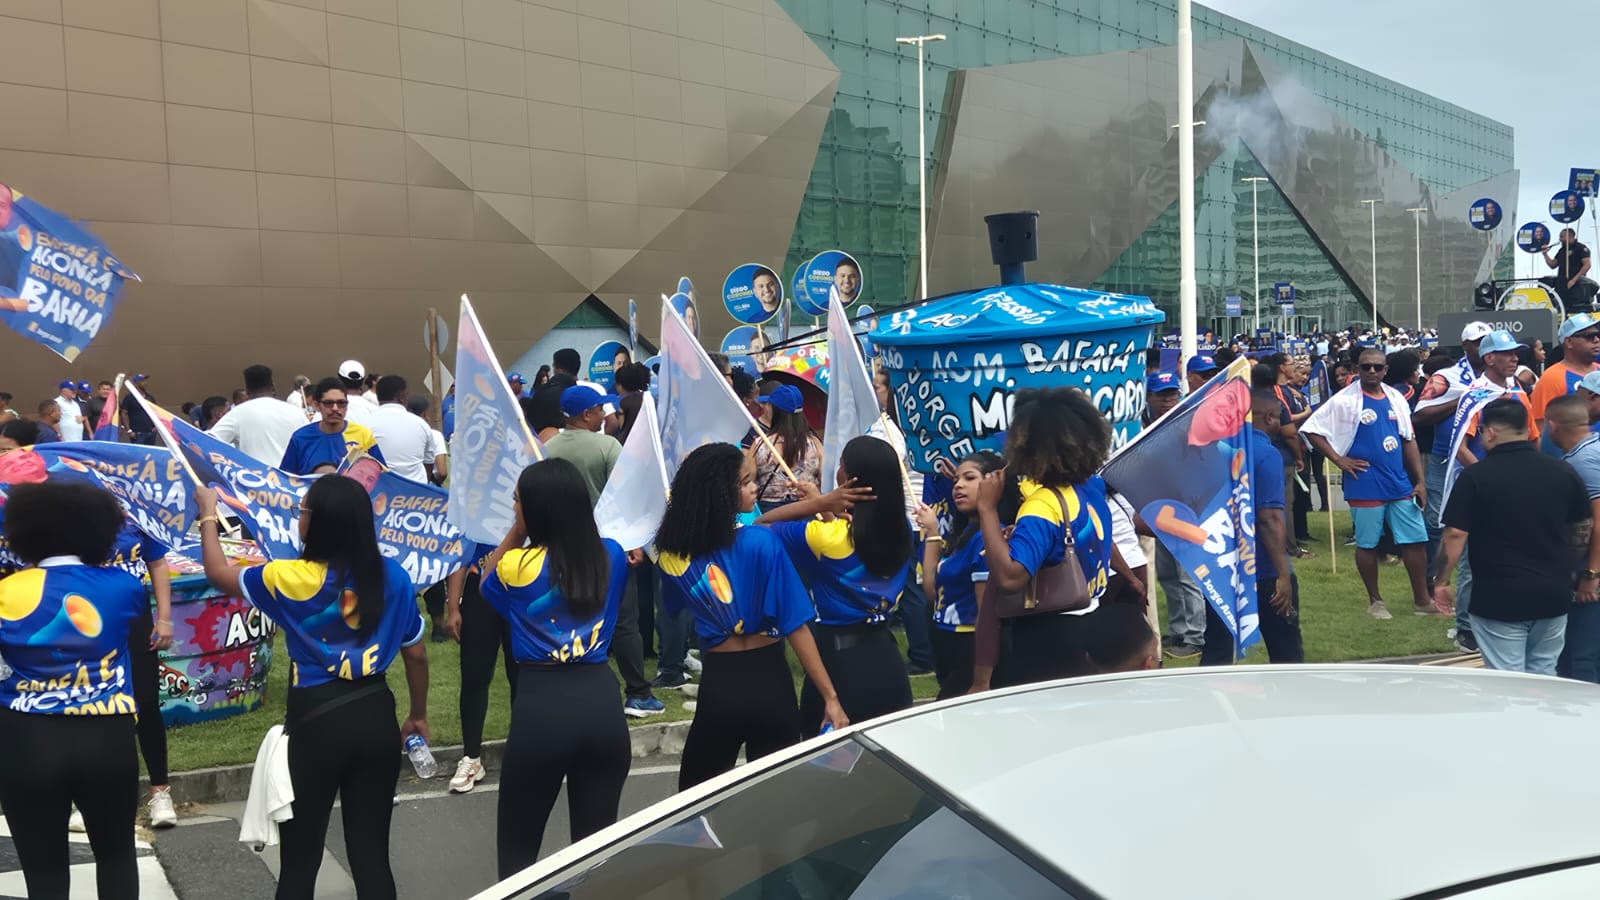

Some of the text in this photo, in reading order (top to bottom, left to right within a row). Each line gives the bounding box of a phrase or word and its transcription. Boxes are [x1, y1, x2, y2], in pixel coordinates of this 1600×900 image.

[19, 277, 103, 339] BAHIA
[52, 275, 82, 297] POVO
[84, 288, 107, 308] DA
[908, 366, 974, 460] JORGE
[247, 488, 294, 511] POVO
[158, 508, 186, 532] DA
[379, 527, 464, 557] PELO POVO DA
[1202, 578, 1225, 611] Jorge
